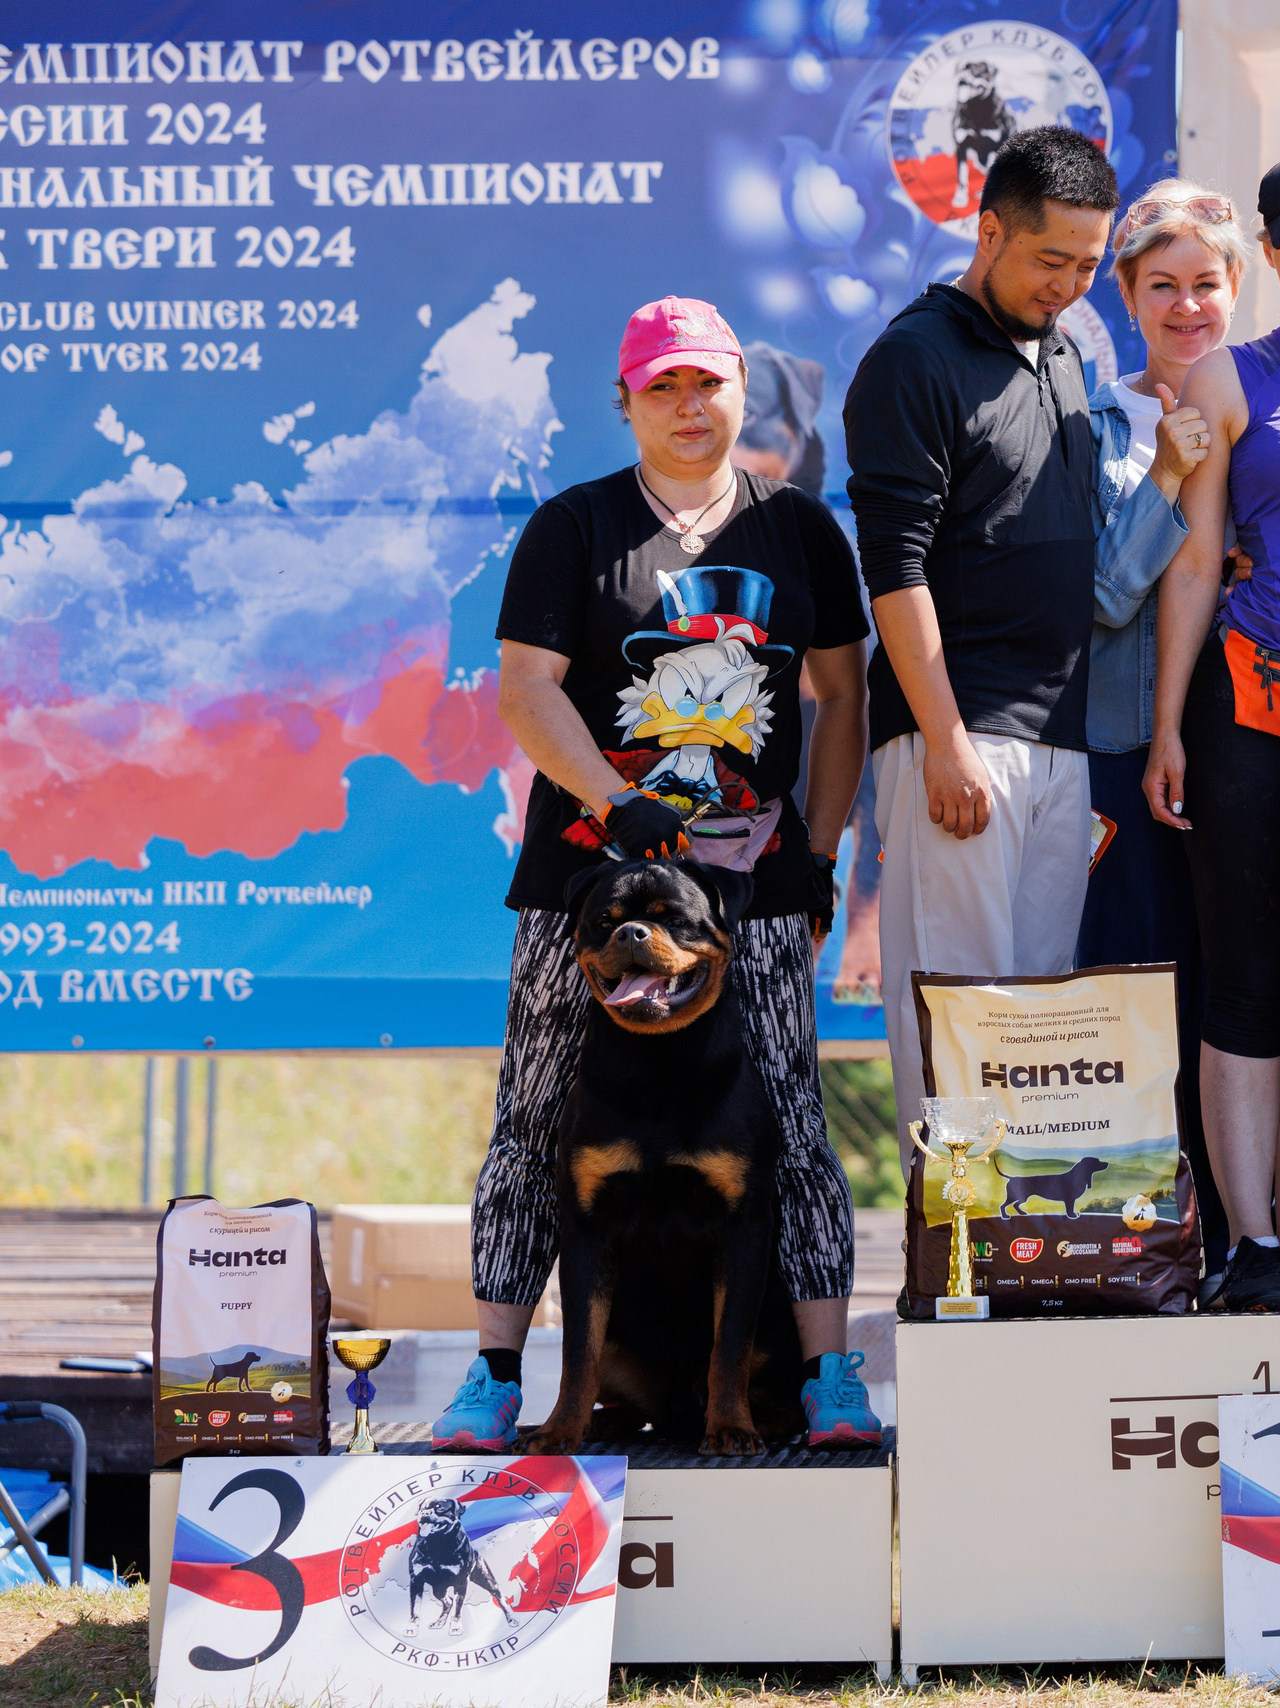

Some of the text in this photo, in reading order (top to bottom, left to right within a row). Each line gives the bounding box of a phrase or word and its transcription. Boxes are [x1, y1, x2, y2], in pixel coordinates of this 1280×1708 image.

[321, 28, 722, 84] РОТВЕЙЛЕРОВ
[145, 102, 268, 146] 2024
[0, 155, 663, 209] НАЛЬНЫЙ ЧЕМПИОНАТ
[27, 226, 218, 270] ТВЕРИ
[234, 225, 357, 269] 2024
[107, 300, 267, 331] WINNER
[277, 299, 360, 330] 2024
[61, 341, 170, 373] TVER
[180, 341, 263, 372] 2024
[162, 881, 227, 906] НКП
[0, 920, 181, 956] 993-2024
[58, 967, 255, 1002] ВМЕСТЕ
[1005, 1031, 1058, 1044] говядиной
[1066, 1029, 1099, 1043] рисом
[980, 1057, 1124, 1089] Hanta
[1021, 1091, 1080, 1104] premium
[1003, 1118, 1111, 1136] MALL/MEDIUM
[249, 1226, 271, 1235] рисом
[1016, 1241, 1037, 1250] FRESH
[189, 1247, 287, 1267] Hanta
[1016, 1250, 1034, 1259] MEAT
[219, 1270, 258, 1278] premium
[220, 1302, 253, 1310] PUPPY
[1252, 1360, 1280, 1394] 1
[343, 1472, 443, 1618] РОТВЕЙЛЕР
[461, 1468, 541, 1501] КЛУБ
[542, 1504, 576, 1616] РОССИИ
[189, 1468, 306, 1672] 3
[390, 1635, 519, 1668] РКФ-НКПР
